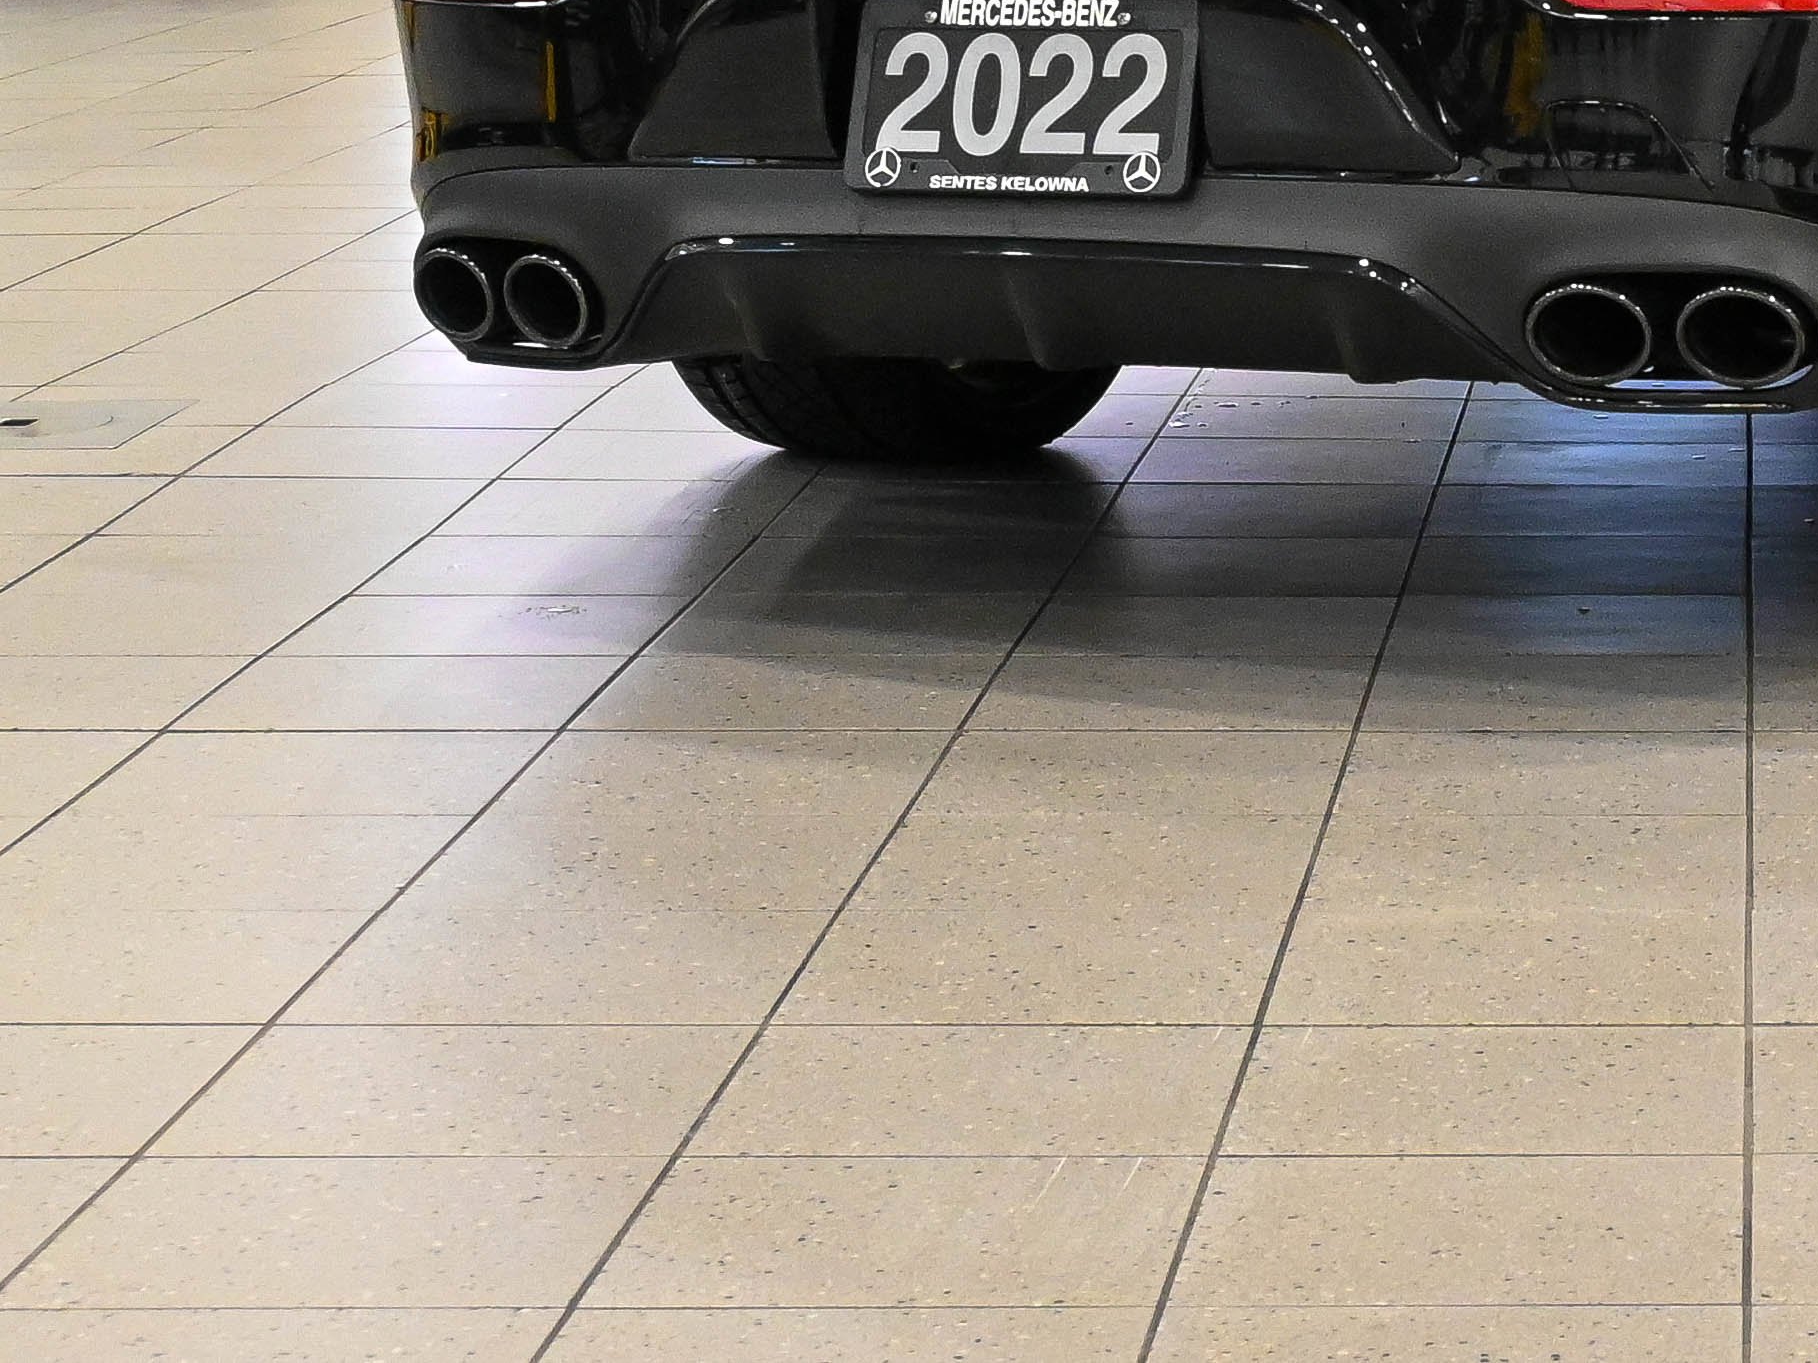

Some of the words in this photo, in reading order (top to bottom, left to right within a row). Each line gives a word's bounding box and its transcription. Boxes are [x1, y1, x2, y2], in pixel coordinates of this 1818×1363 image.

[875, 32, 1168, 156] 2022
[929, 175, 998, 191] SENTES
[1001, 176, 1089, 193] KELOWNA
